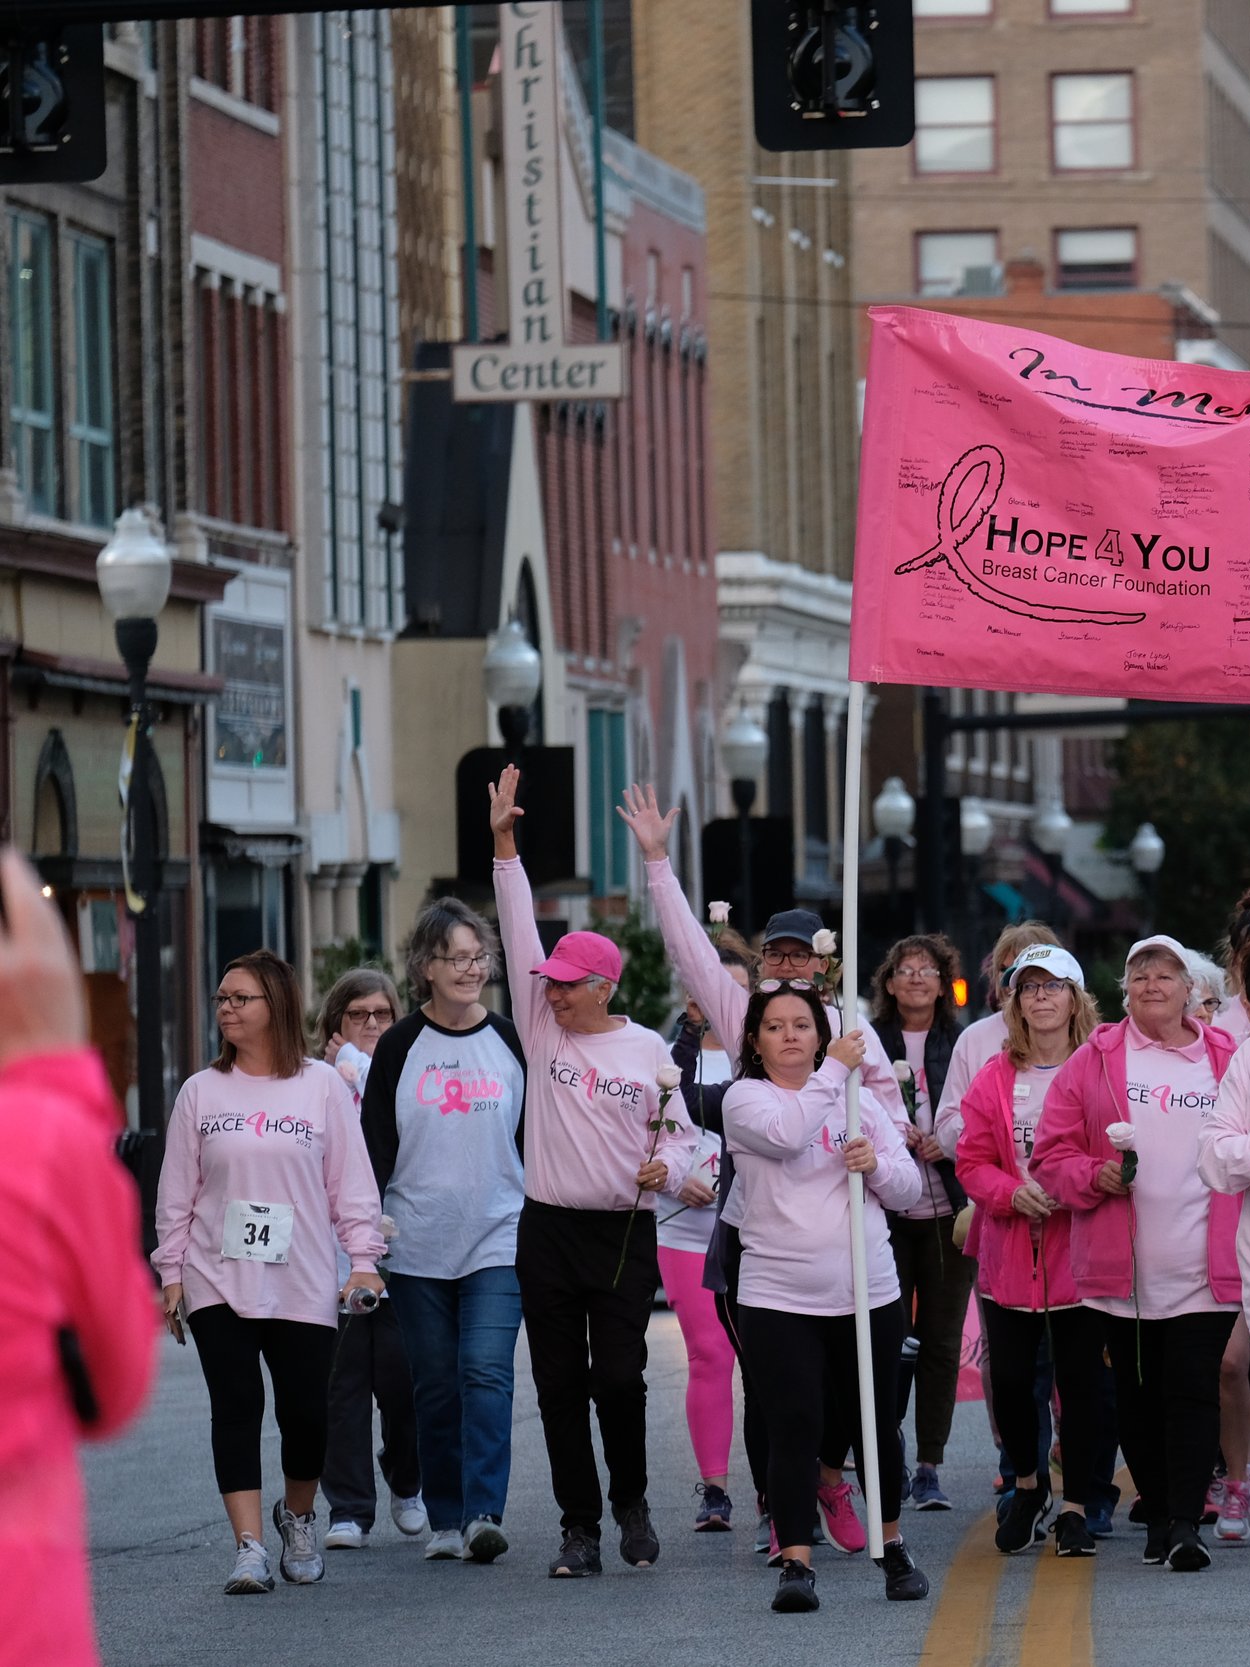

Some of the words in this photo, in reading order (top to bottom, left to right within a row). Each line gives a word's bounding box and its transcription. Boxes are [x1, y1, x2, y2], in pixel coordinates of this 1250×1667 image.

[471, 353, 606, 392] Center
[1008, 347, 1092, 391] In
[1095, 529, 1124, 567] 4
[982, 559, 1038, 581] Breast
[1043, 566, 1108, 588] Cancer
[1113, 573, 1211, 596] Foundation
[595, 1077, 643, 1105] HOPE
[1127, 1086, 1150, 1105] CE
[473, 1100, 499, 1112] 2019
[620, 1101, 637, 1113] 2022
[265, 1119, 314, 1141] HOPE
[295, 1137, 312, 1149] 2022
[244, 1223, 271, 1246] 34
